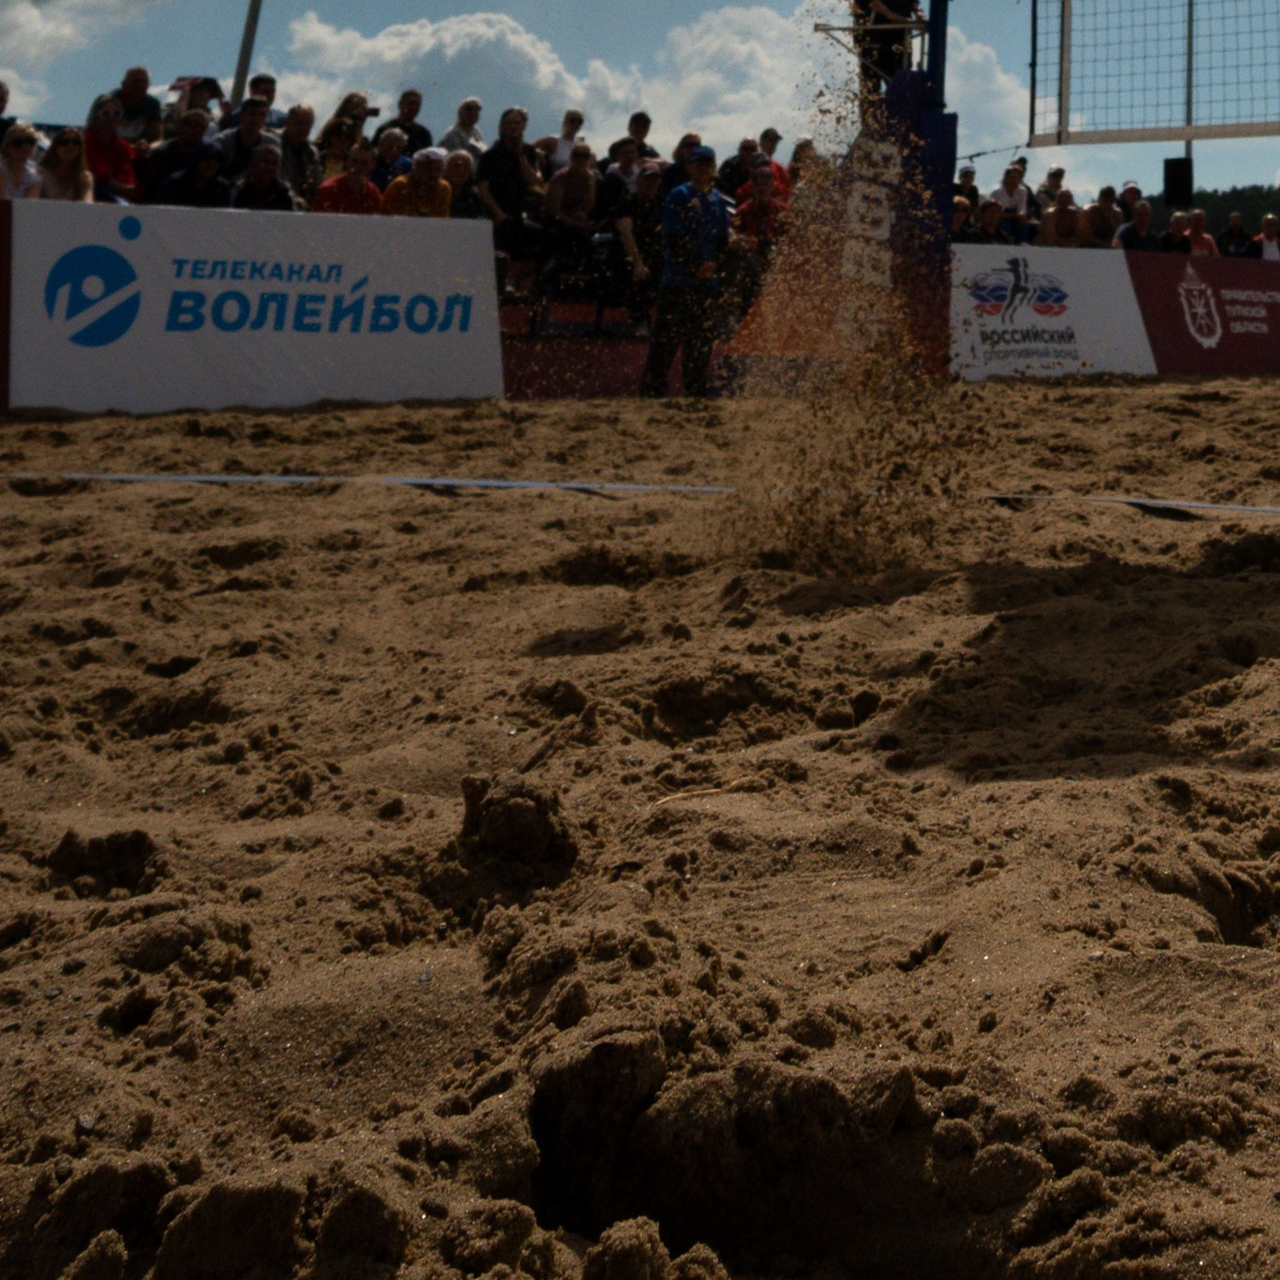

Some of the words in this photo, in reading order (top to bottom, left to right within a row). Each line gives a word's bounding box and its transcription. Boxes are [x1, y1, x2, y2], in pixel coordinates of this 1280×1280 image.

[172, 259, 343, 283] ТЕЛЕКАНАЛ
[165, 275, 473, 333] ВОЛЕЙБОЛ
[980, 325, 1077, 345] РОССИЙСКИЙ
